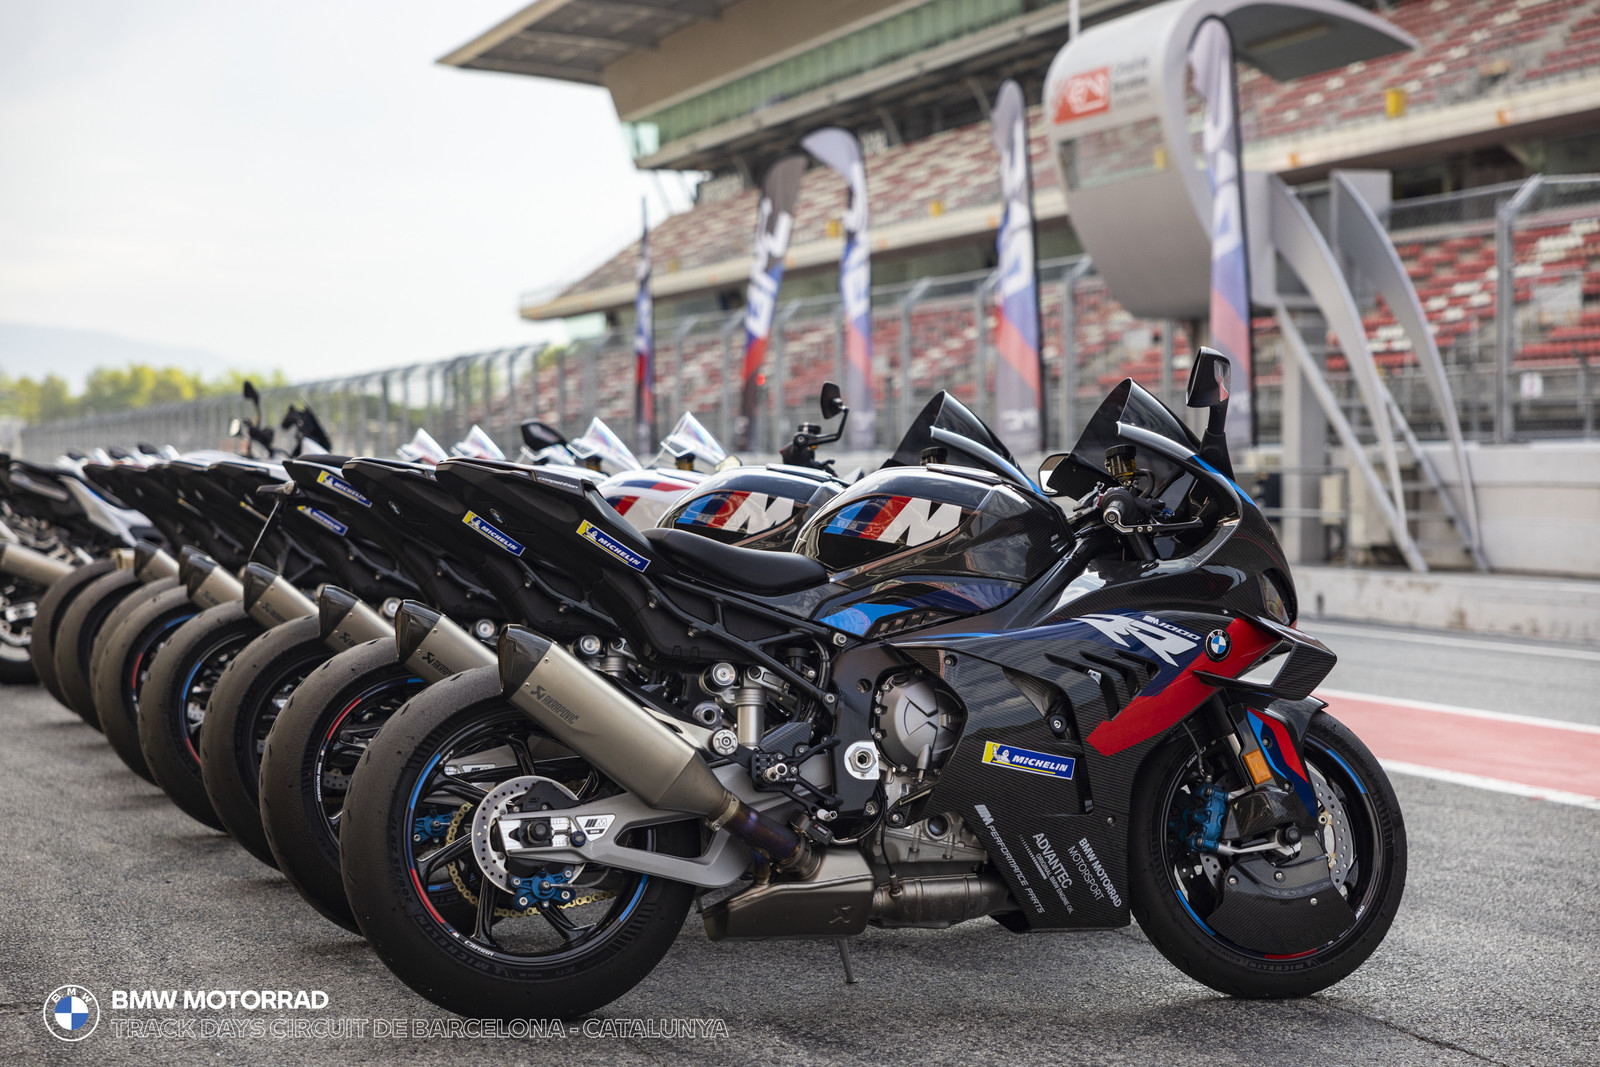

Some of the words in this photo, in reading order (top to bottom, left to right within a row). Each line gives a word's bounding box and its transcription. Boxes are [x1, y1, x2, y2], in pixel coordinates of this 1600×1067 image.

[480, 525, 518, 551] MICHELIN
[597, 537, 641, 566] MICHELIN
[1160, 622, 1202, 641] 1000
[1012, 754, 1069, 772] MICHELIN
[986, 825, 1029, 887] PERFORMANCE
[1024, 887, 1046, 914] PARTS
[1032, 832, 1073, 889] ADVANTEC
[1035, 853, 1052, 878] ORIGINAL
[1049, 876, 1060, 890] BMW
[1056, 887, 1069, 907] ENGINE
[1066, 904, 1074, 915] OIL
[1067, 845, 1105, 901] MOTORSPORT
[1078, 837, 1097, 866] BMW
[1091, 861, 1122, 908] MOTORRAD
[415, 913, 489, 973] MICHELIN
